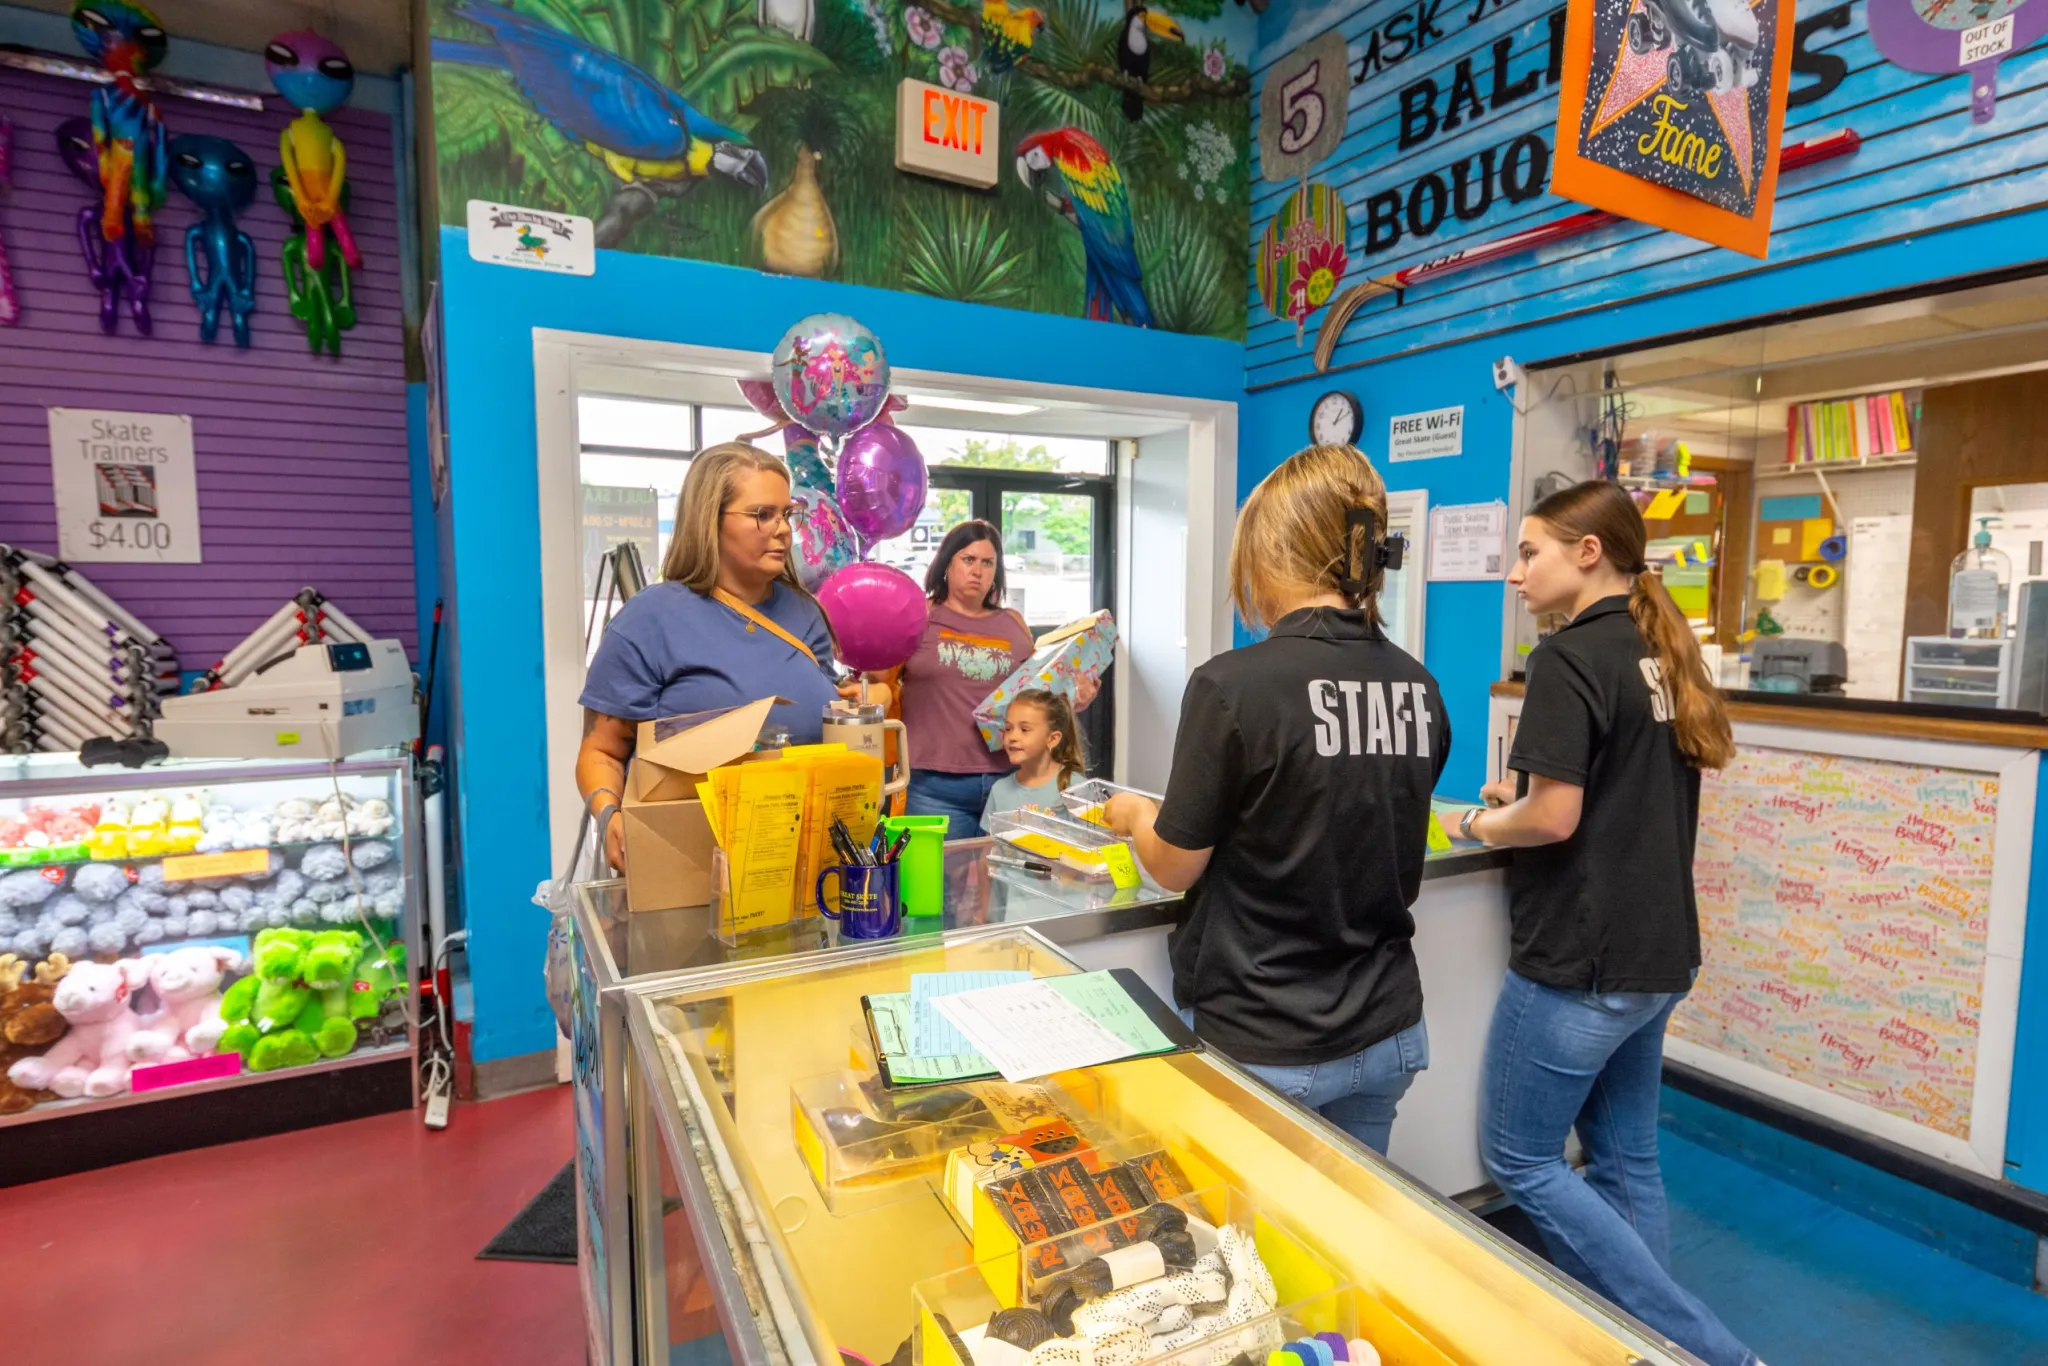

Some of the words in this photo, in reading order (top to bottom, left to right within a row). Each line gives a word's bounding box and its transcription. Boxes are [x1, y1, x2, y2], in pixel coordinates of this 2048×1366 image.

[1354, 0, 1443, 84] ASK
[1965, 26, 1990, 44] OUT
[1993, 20, 2008, 35] OF
[1967, 38, 2005, 60] STOCK
[1279, 59, 1325, 154] 5
[924, 89, 988, 155] EXIT
[1638, 94, 1722, 179] Fame
[1364, 132, 1549, 256] BOUQ
[91, 419, 152, 442] Skate
[1392, 418, 1422, 435] FREE
[1426, 411, 1461, 430] Wi-Fi
[78, 439, 169, 463] Trainers
[1394, 437, 1412, 446] Great
[1413, 434, 1431, 443] Skate
[1432, 430, 1457, 442] (Guest)
[88, 520, 171, 549] $4.00
[1308, 679, 1432, 757] STAFF
